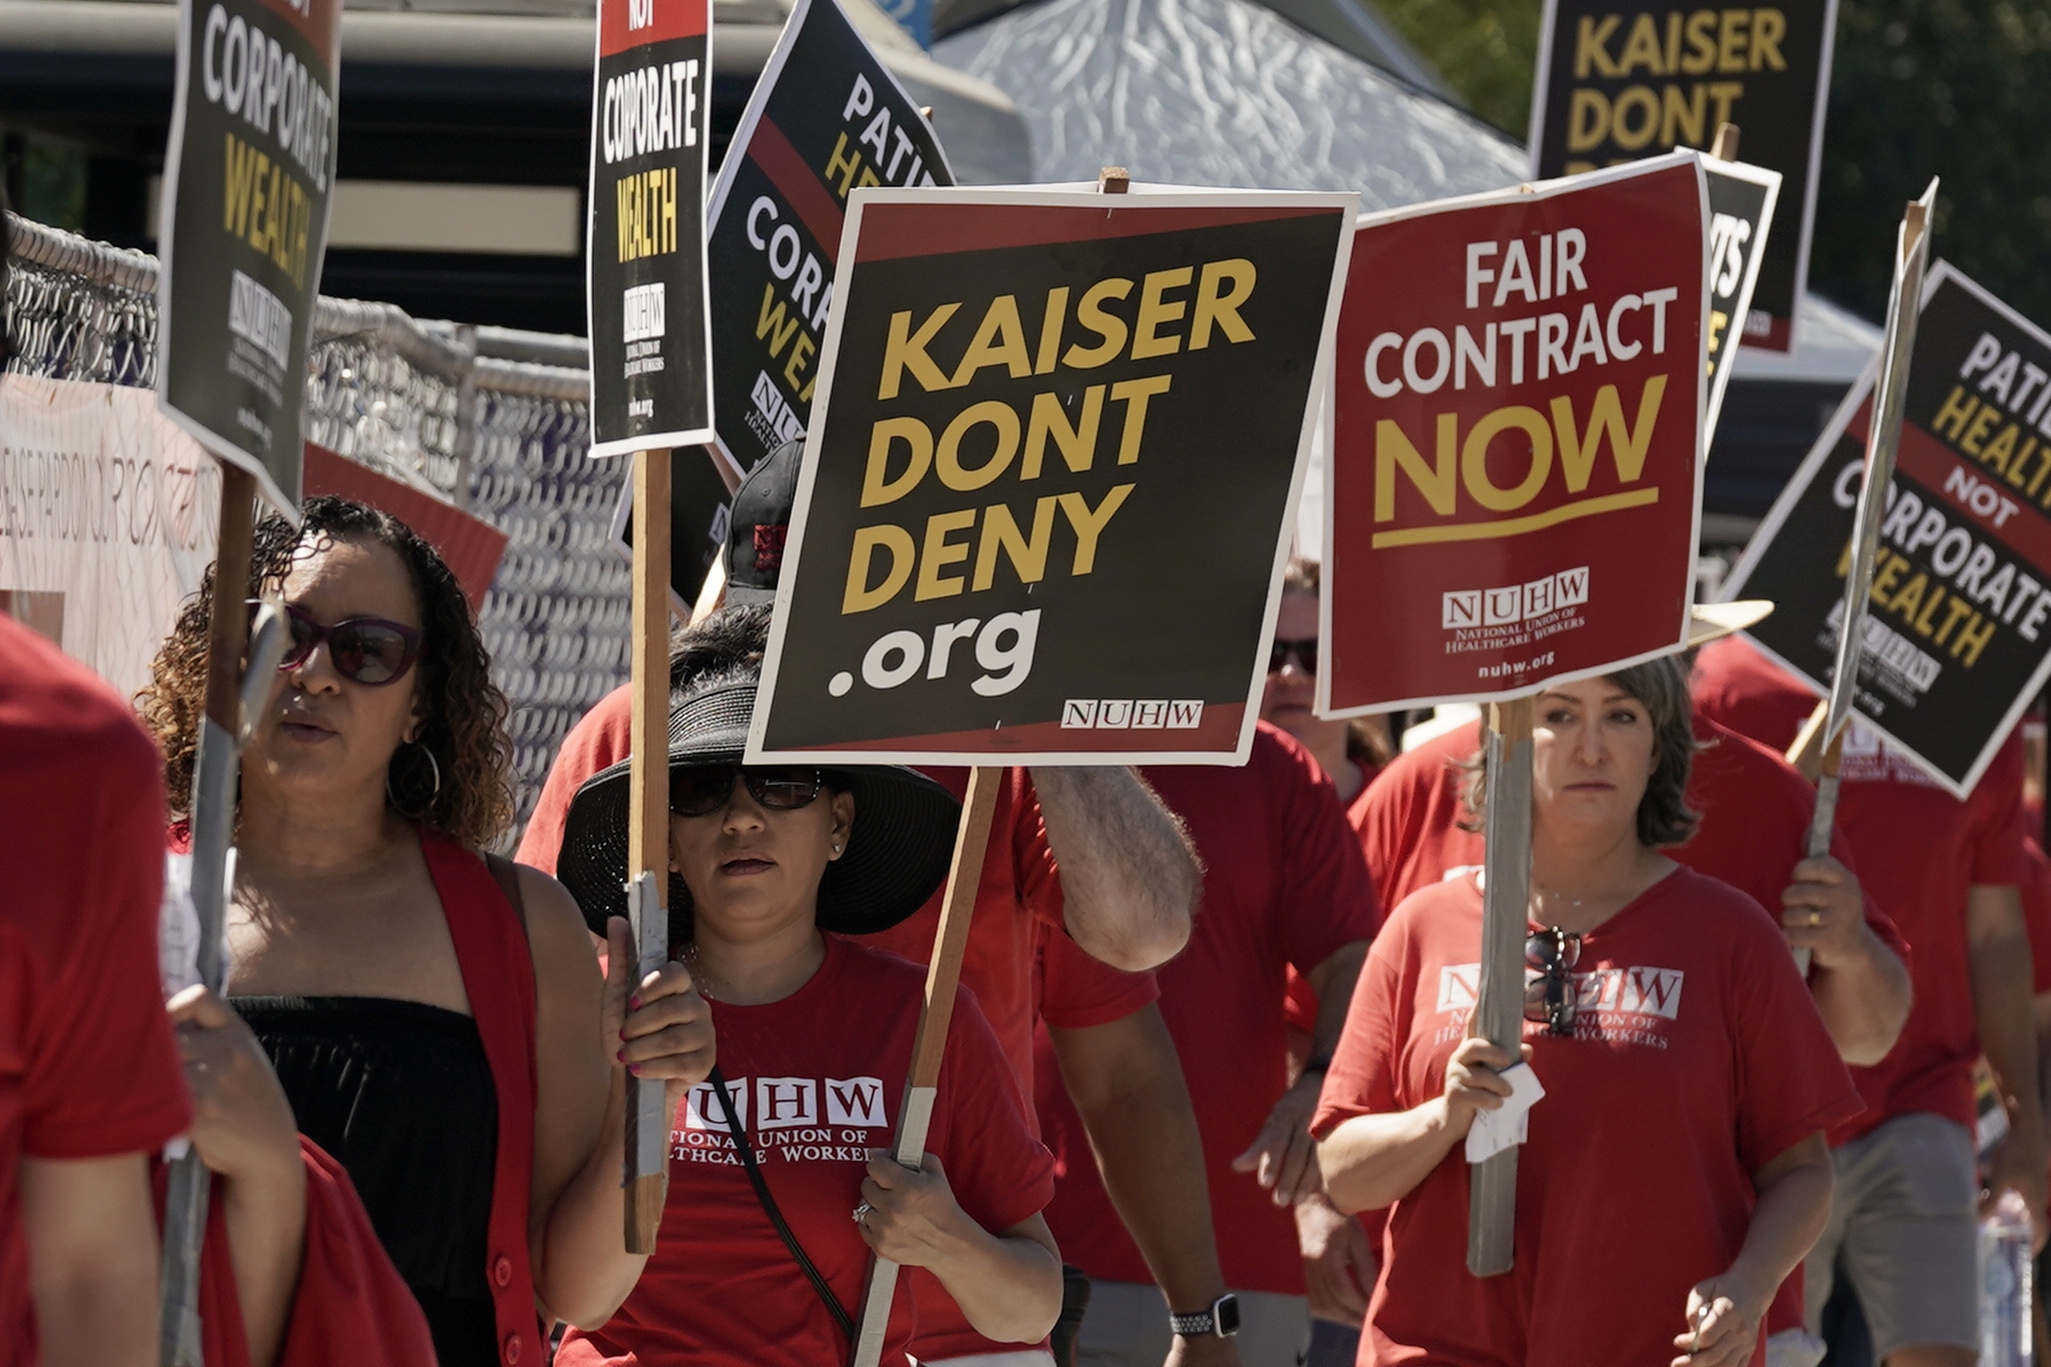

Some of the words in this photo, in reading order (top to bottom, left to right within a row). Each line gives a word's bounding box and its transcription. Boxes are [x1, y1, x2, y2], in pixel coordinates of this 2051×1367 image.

[1575, 8, 1787, 79] KAISER
[203, 3, 332, 194] CORPORATE
[603, 59, 698, 164] CORPORATE
[842, 72, 938, 187] PATI
[1567, 82, 1744, 151] DONT
[223, 131, 311, 292] WEALTH
[617, 167, 677, 263] WEALTH
[1466, 227, 1589, 309] FAIR
[878, 257, 1257, 400] KAISER
[1364, 286, 1678, 398] CONTRACT
[860, 374, 1172, 509] DONT
[1374, 373, 1668, 523] NOW
[1944, 464, 2020, 529] NOT
[841, 483, 1136, 616] DENY
[1832, 458, 2051, 643] CRPORATE
[1444, 567, 1588, 629] NUHW
[828, 608, 1042, 697] .org
[1478, 651, 1555, 678] nuhw.org
[1062, 700, 1204, 729] NUHW
[1573, 1026, 1668, 1050] WORKERS
[758, 1129, 832, 1148] UNION
[841, 1129, 867, 1144] OF
